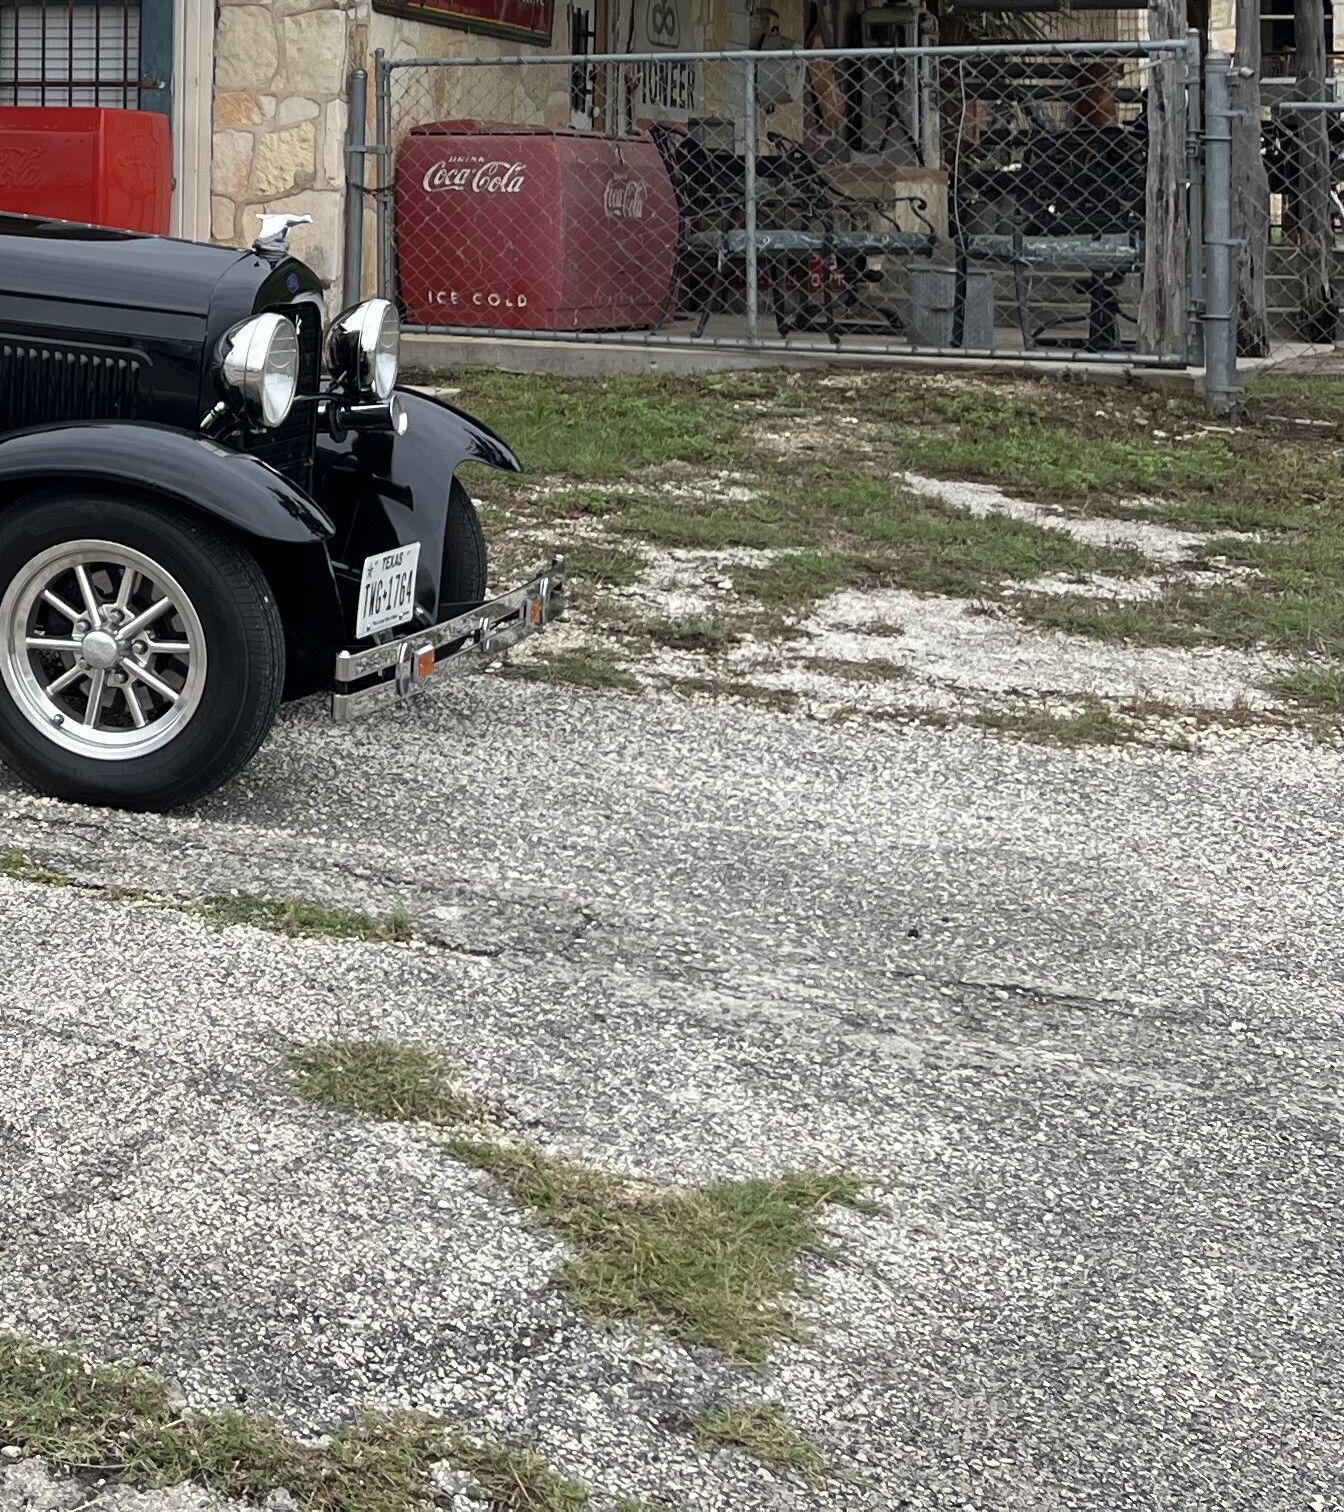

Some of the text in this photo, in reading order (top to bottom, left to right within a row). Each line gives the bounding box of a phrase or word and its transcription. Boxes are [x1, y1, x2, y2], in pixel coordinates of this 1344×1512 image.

[423, 161, 527, 193] Coca-Cola
[428, 291, 528, 308] ICE COLD
[382, 552, 404, 570] TEXAS
